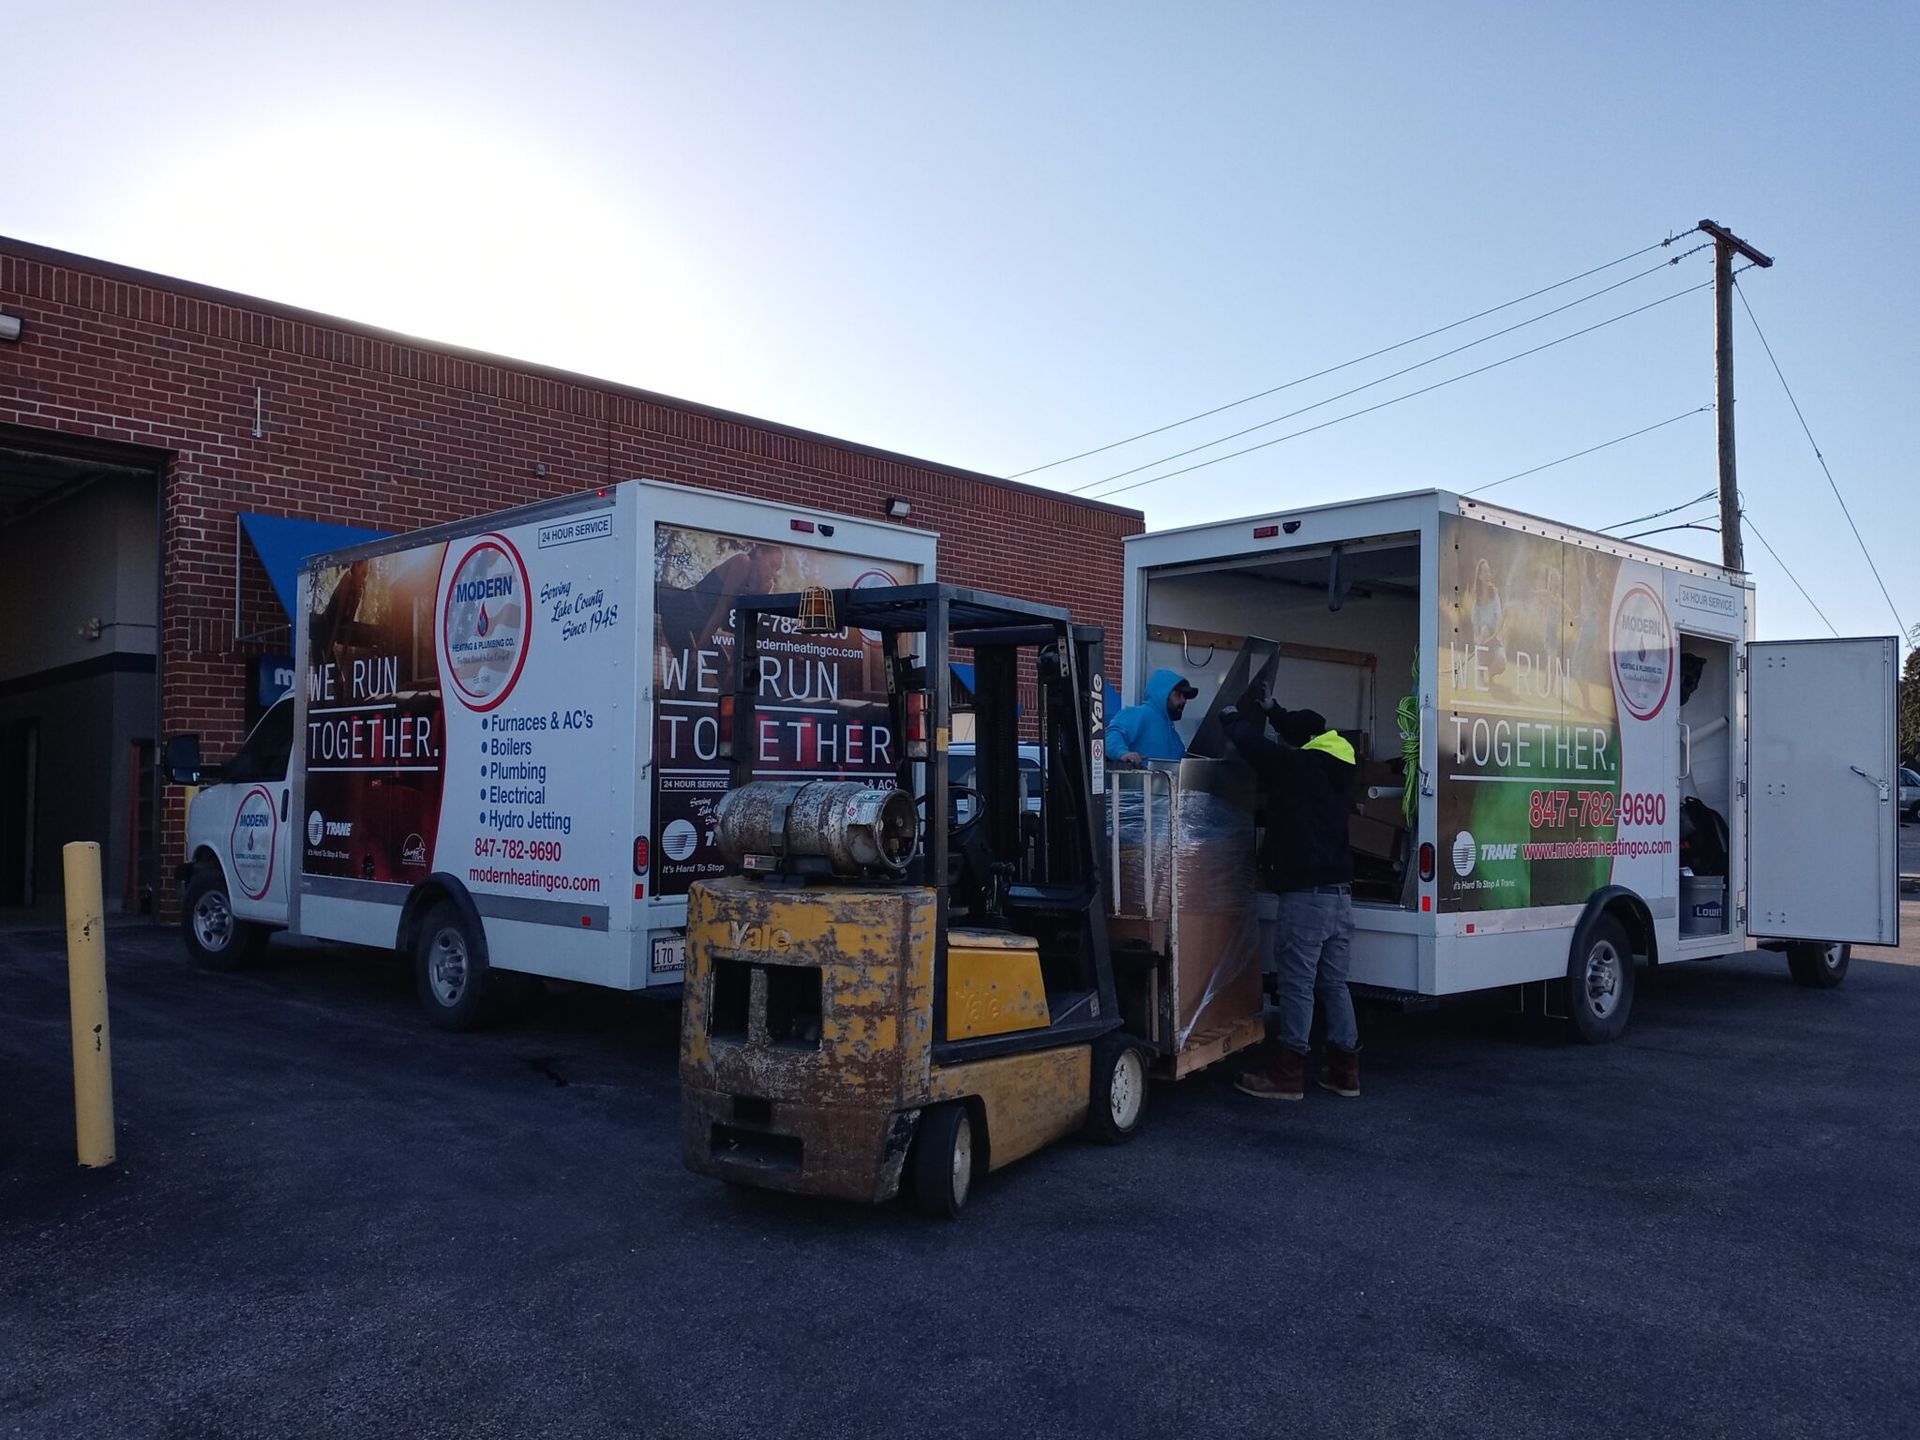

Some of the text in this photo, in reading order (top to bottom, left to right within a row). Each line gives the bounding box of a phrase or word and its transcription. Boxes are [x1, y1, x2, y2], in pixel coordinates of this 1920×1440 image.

[541, 520, 608, 543] 24 HOUR SERVICE
[456, 576, 513, 603] MODERN
[541, 582, 571, 604] Serving
[1682, 590, 1732, 611] 24 HOUR SERVICE
[551, 589, 604, 623] Lake County
[563, 604, 618, 641] Since 1948
[1622, 615, 1660, 636] MODERN
[310, 663, 335, 702] WE
[353, 656, 397, 699] RUN
[660, 646, 838, 701] WE RUN
[1450, 642, 1570, 700] WE RUN
[1091, 673, 1103, 734] Yale
[491, 709, 593, 732] Furnaces & AC's
[309, 716, 439, 760] TOGETHER.
[491, 738, 532, 756] Boilers
[660, 715, 891, 764] TOETHER
[1450, 716, 1616, 771] TOGETHER.
[490, 762, 546, 784] Plumbing
[697, 780, 728, 788] SERVICE
[490, 785, 545, 804] Electrical
[240, 814, 269, 827] MODERN
[1529, 789, 1666, 828] 847-782-9690
[326, 821, 353, 836] TRANE
[489, 809, 571, 835] Hydro Jetting
[475, 837, 561, 862] 847-782-9690
[1481, 843, 1518, 861] TRANE
[1522, 837, 1672, 860] www.modernheatingco.com
[469, 866, 600, 893] modernheatingco.com
[662, 864, 724, 874] It's Hard To Stop
[730, 920, 791, 952] Yale
